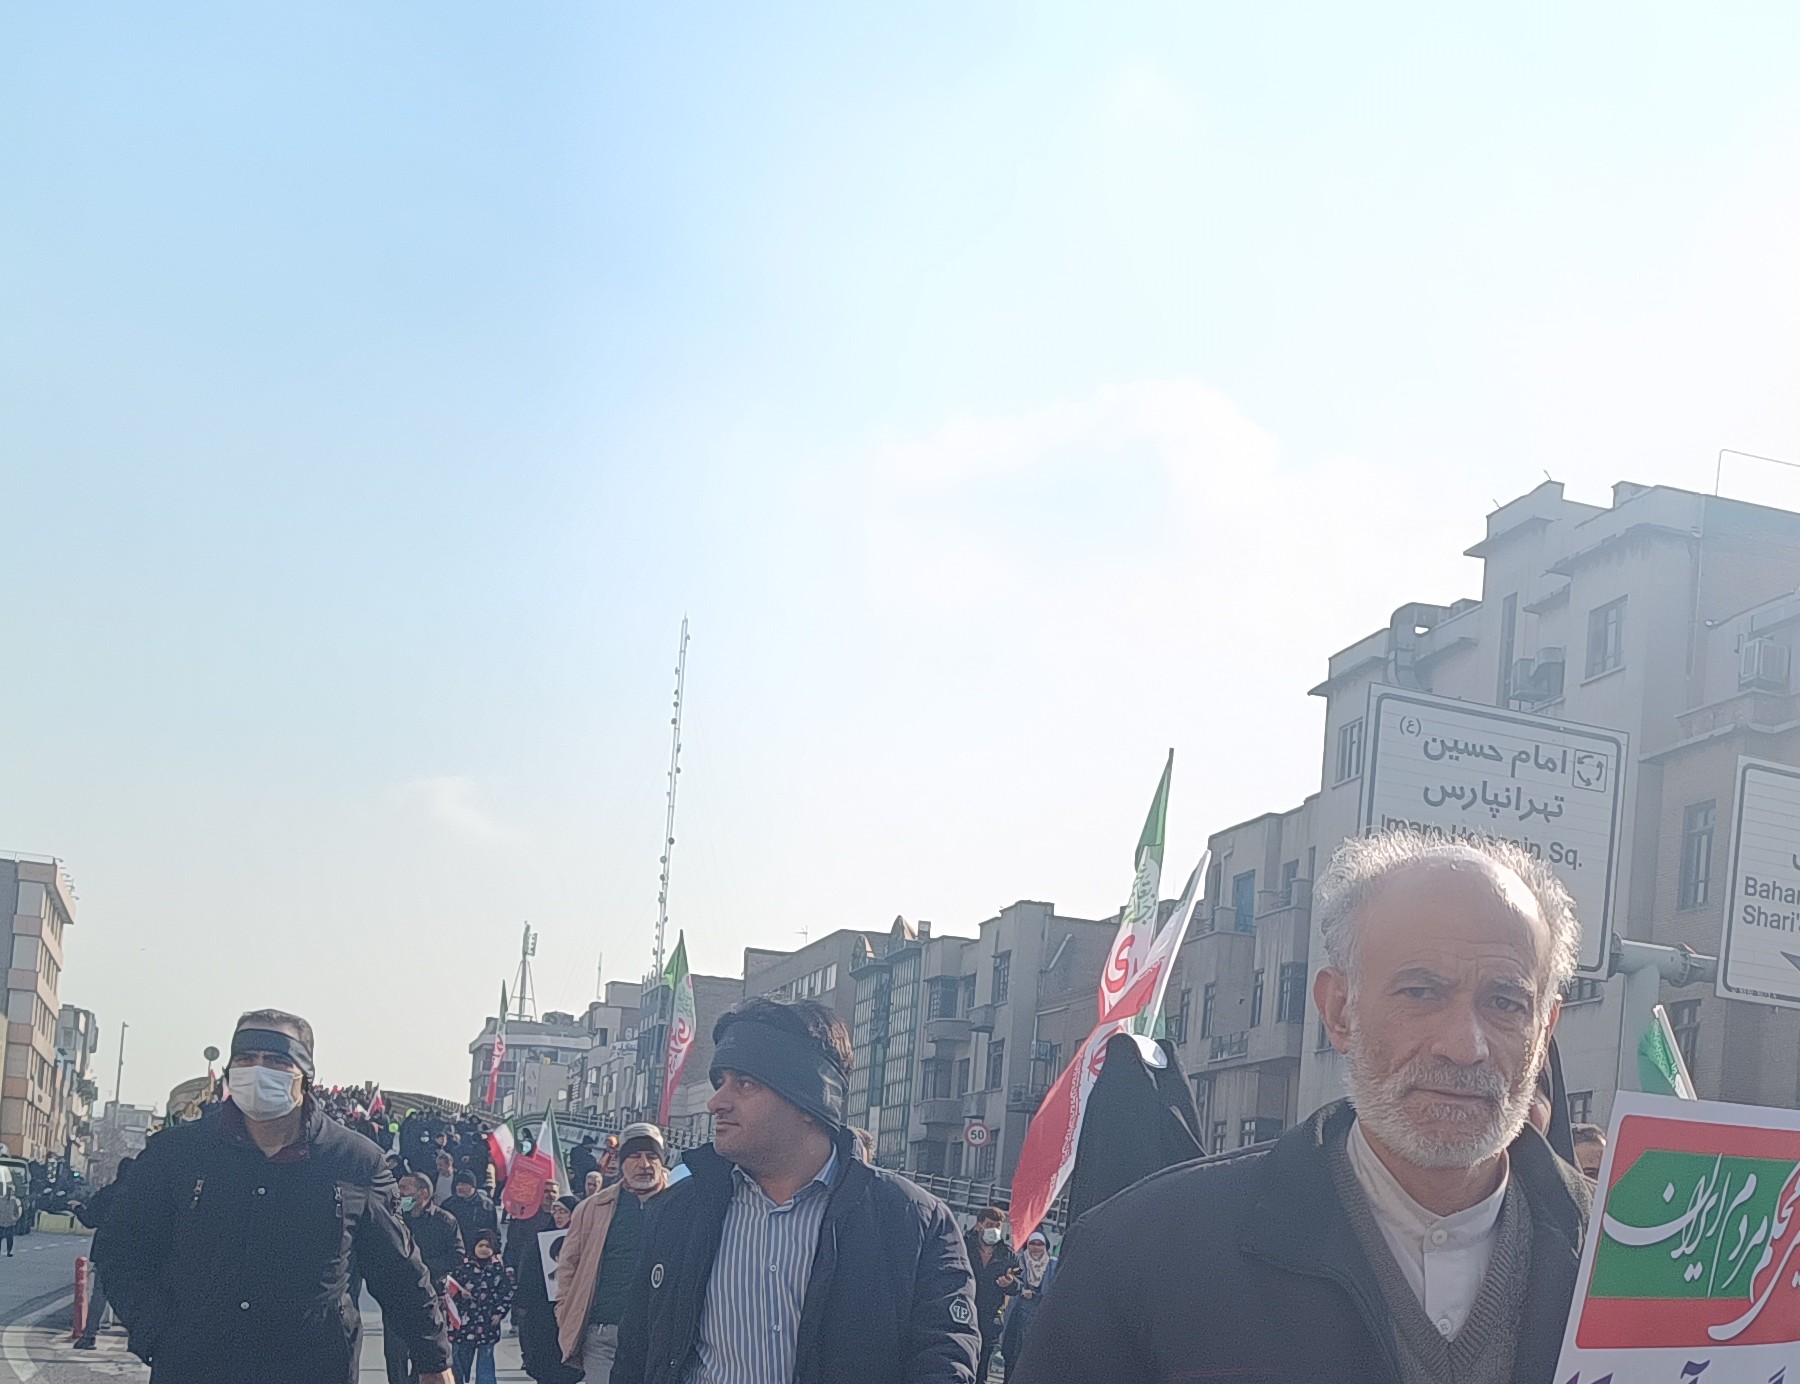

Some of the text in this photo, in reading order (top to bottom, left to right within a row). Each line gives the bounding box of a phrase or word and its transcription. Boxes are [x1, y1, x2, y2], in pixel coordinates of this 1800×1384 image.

[1423, 737, 1503, 762] حسین
[1511, 744, 1568, 778] امام
[1423, 780, 1565, 823] تهرانپارس
[1549, 841, 1583, 871] Sq.
[970, 1129, 985, 1140] 50
